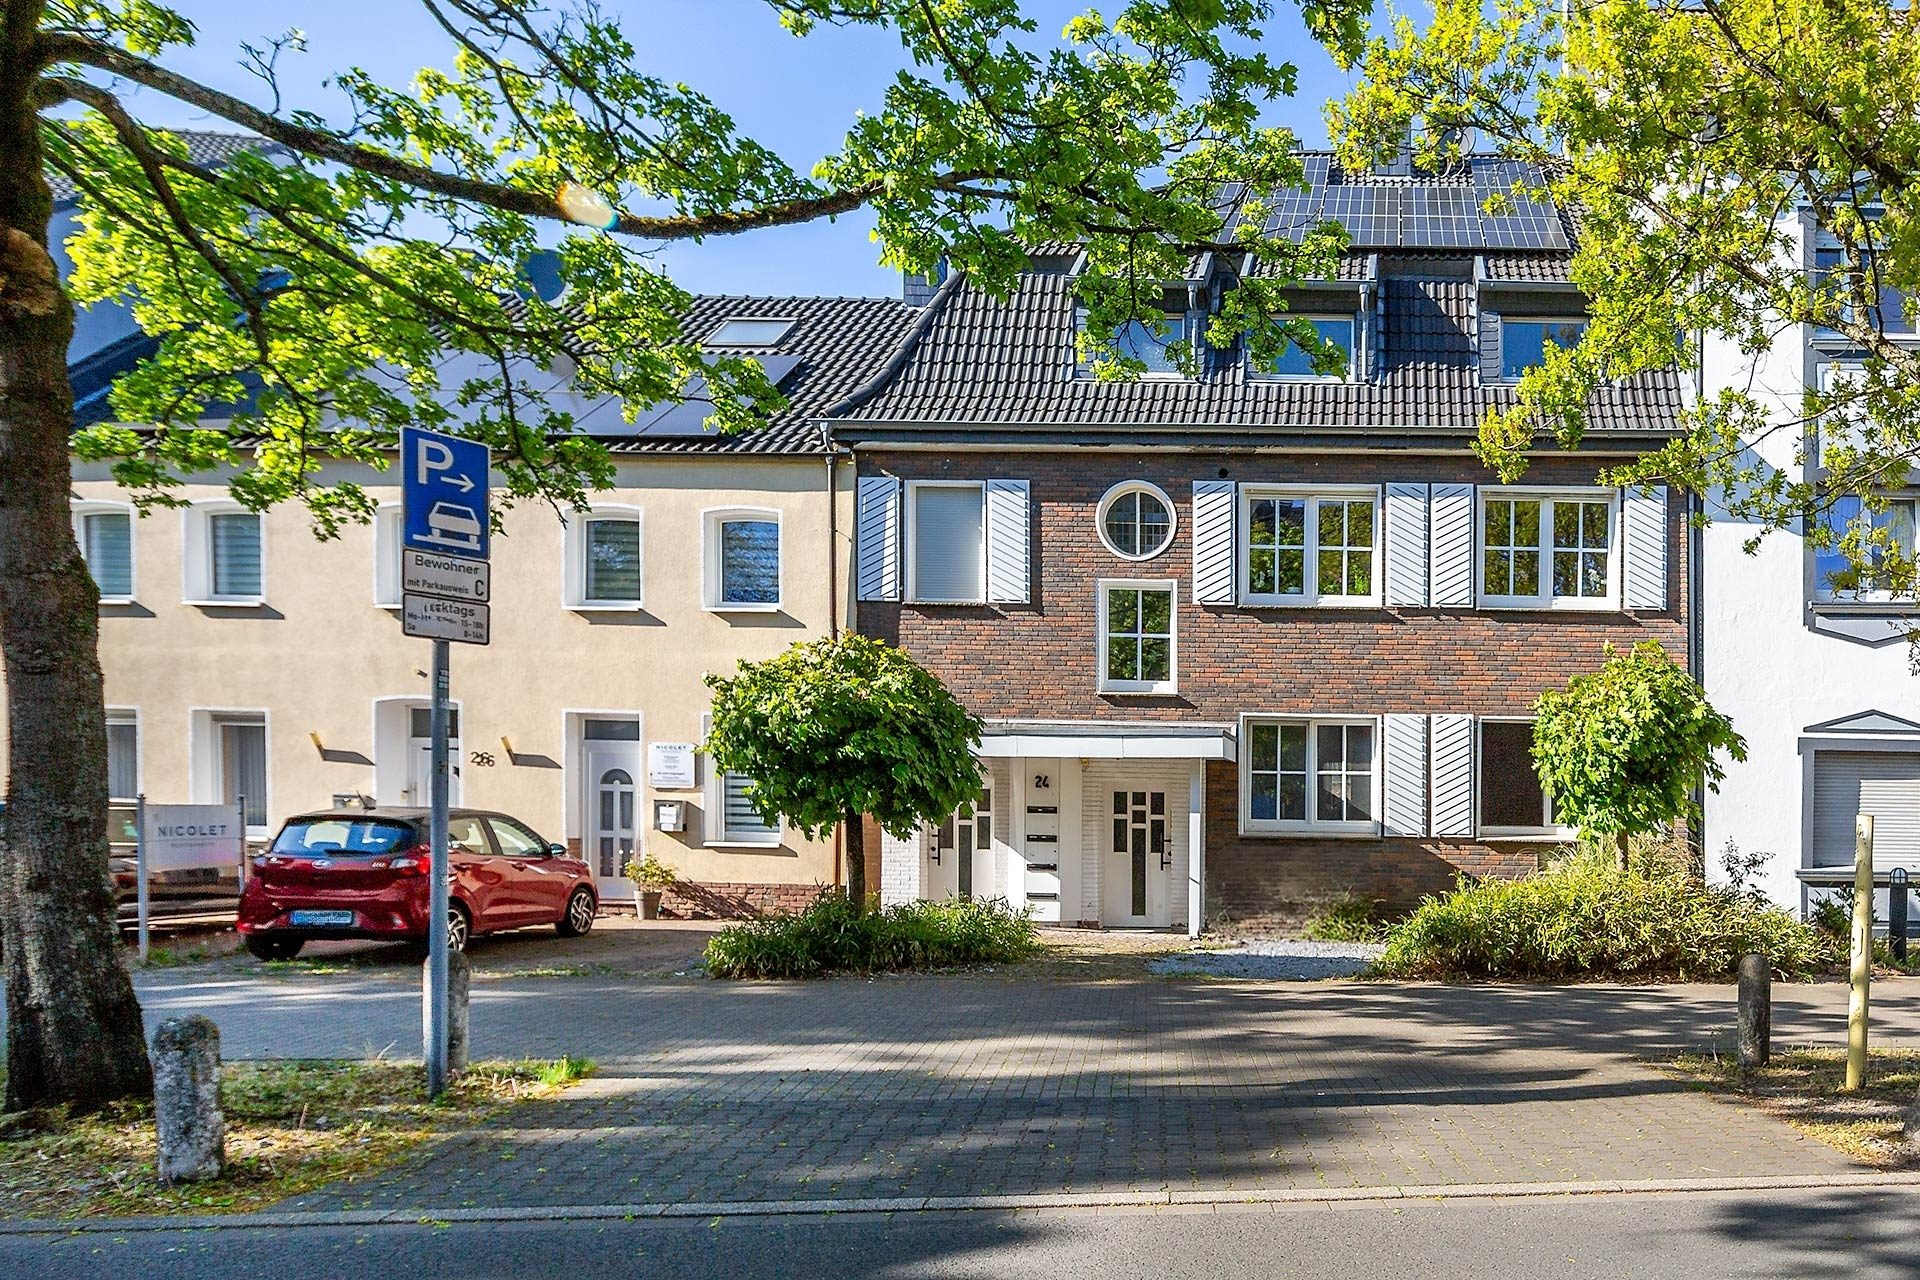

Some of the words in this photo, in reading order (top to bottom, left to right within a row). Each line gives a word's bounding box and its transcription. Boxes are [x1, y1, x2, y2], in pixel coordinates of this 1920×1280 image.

[417, 437, 454, 485] P
[415, 555, 480, 575] Bewohner
[407, 579, 420, 587] mit
[422, 580, 469, 594] Parkausweis
[475, 580, 484, 597] C
[1034, 775, 1050, 789] 24
[157, 825, 227, 837] NICOLET
